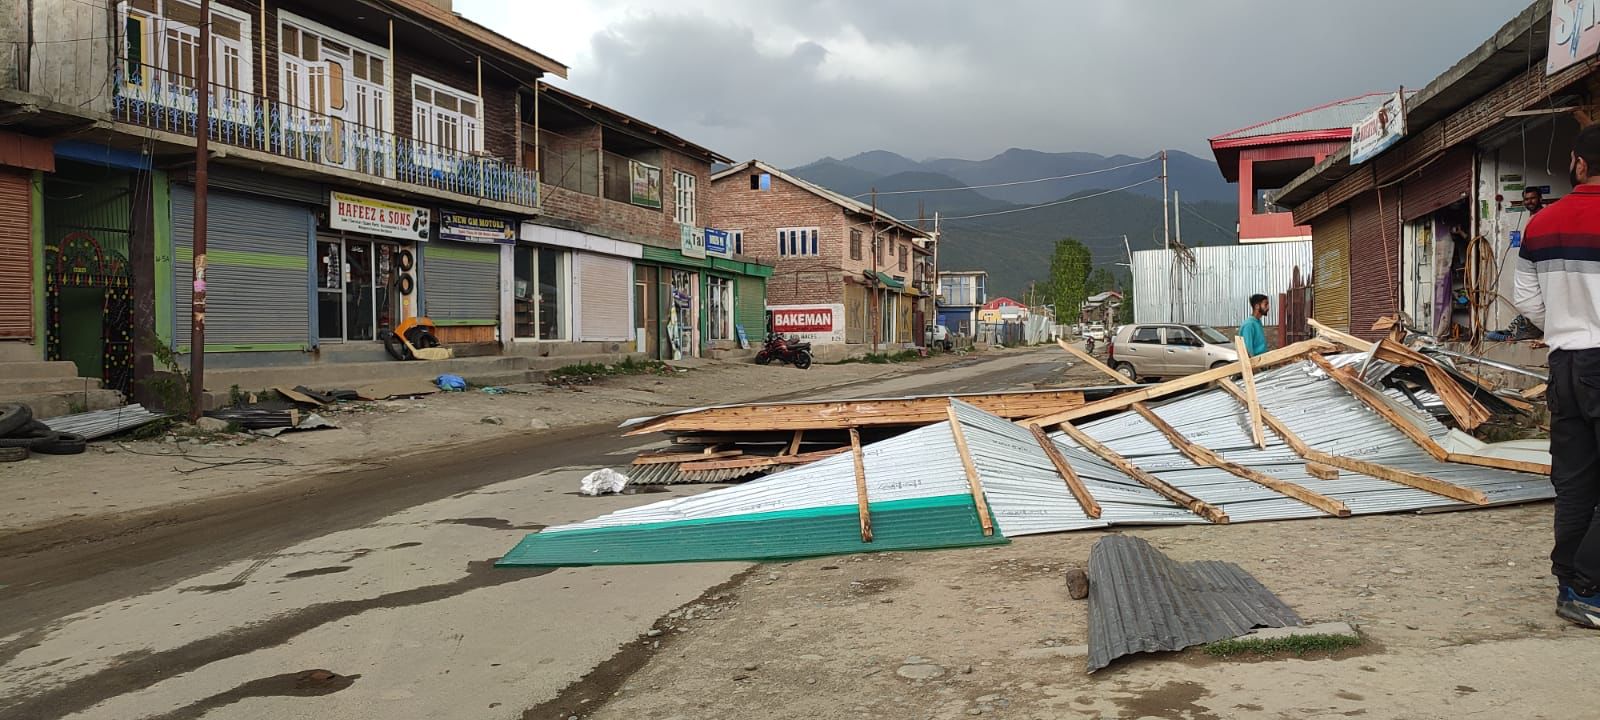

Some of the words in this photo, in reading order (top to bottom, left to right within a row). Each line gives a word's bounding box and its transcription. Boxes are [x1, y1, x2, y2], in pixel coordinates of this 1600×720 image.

[338, 202, 376, 221] HAFEEZ
[379, 209, 385, 222] &
[388, 211, 411, 226] SONS
[452, 215, 467, 225] NEW
[479, 218, 505, 228] MOTORS
[775, 313, 831, 326] BAKEMAN
